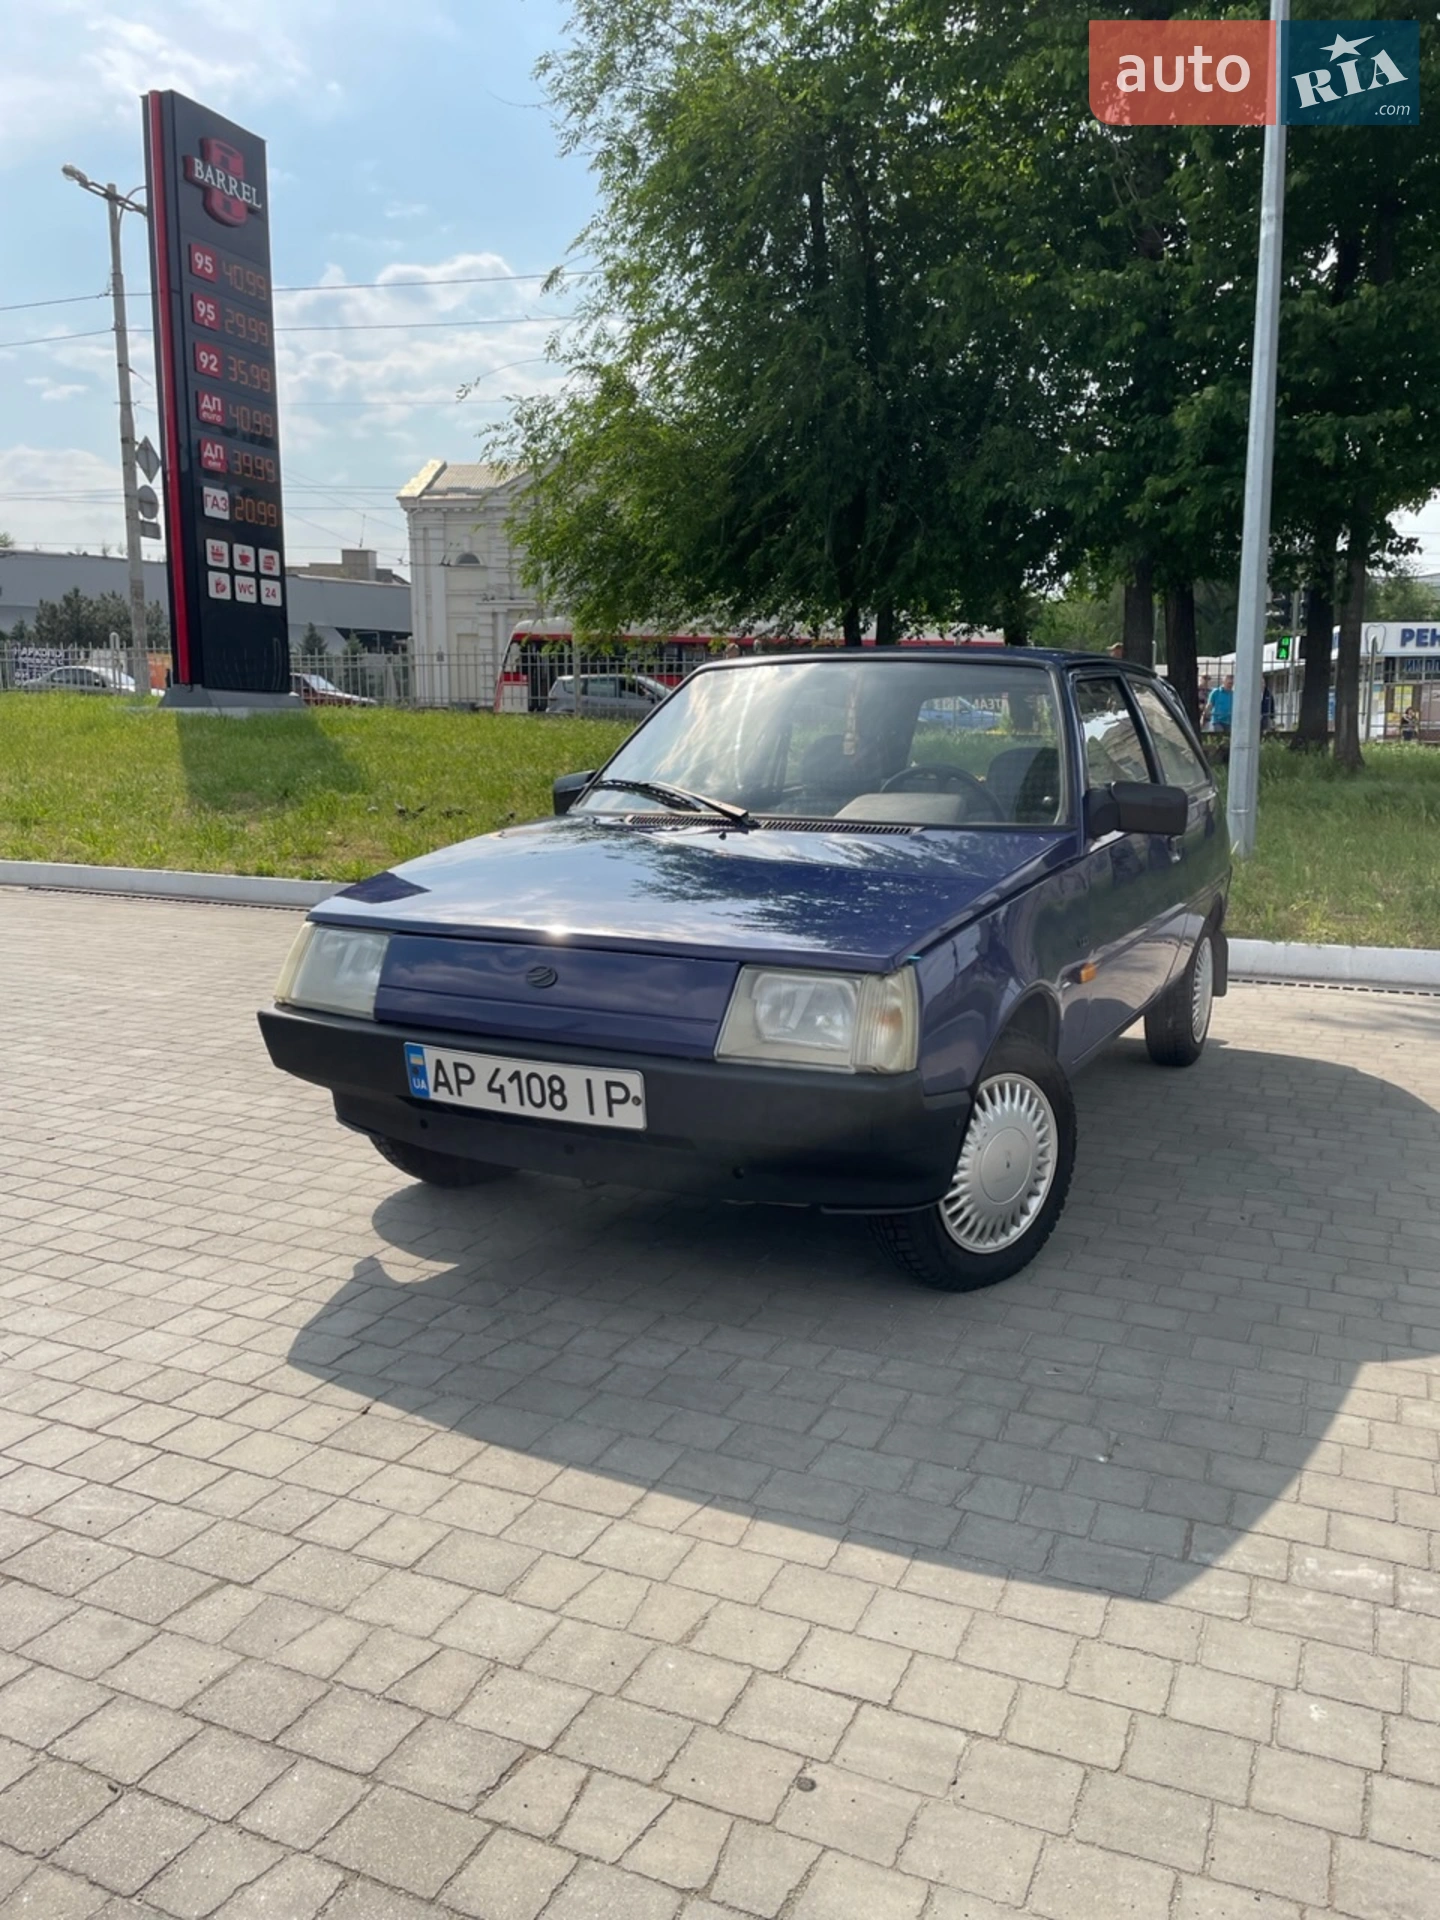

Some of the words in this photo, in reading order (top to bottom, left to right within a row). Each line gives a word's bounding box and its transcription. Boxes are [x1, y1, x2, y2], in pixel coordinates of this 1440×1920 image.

[193, 157, 262, 208] BARREL
[194, 251, 214, 275] 95
[196, 300, 216, 322] 95
[225, 307, 269, 347] 29.99
[199, 351, 219, 372] 92
[228, 356, 271, 393] 35.99
[201, 394, 222, 412] ДП
[202, 411, 222, 423] euro
[203, 442, 224, 460] ДП
[204, 493, 229, 512] ГАЗ
[235, 495, 277, 528] 20.99
[237, 583, 255, 596] WC
[265, 587, 277, 599] 24
[1400, 628, 1440, 647] РЕН
[413, 1078, 427, 1090] UA
[433, 1059, 475, 1097] AP
[487, 1067, 567, 1111] 4108
[585, 1078, 631, 1118] IP
